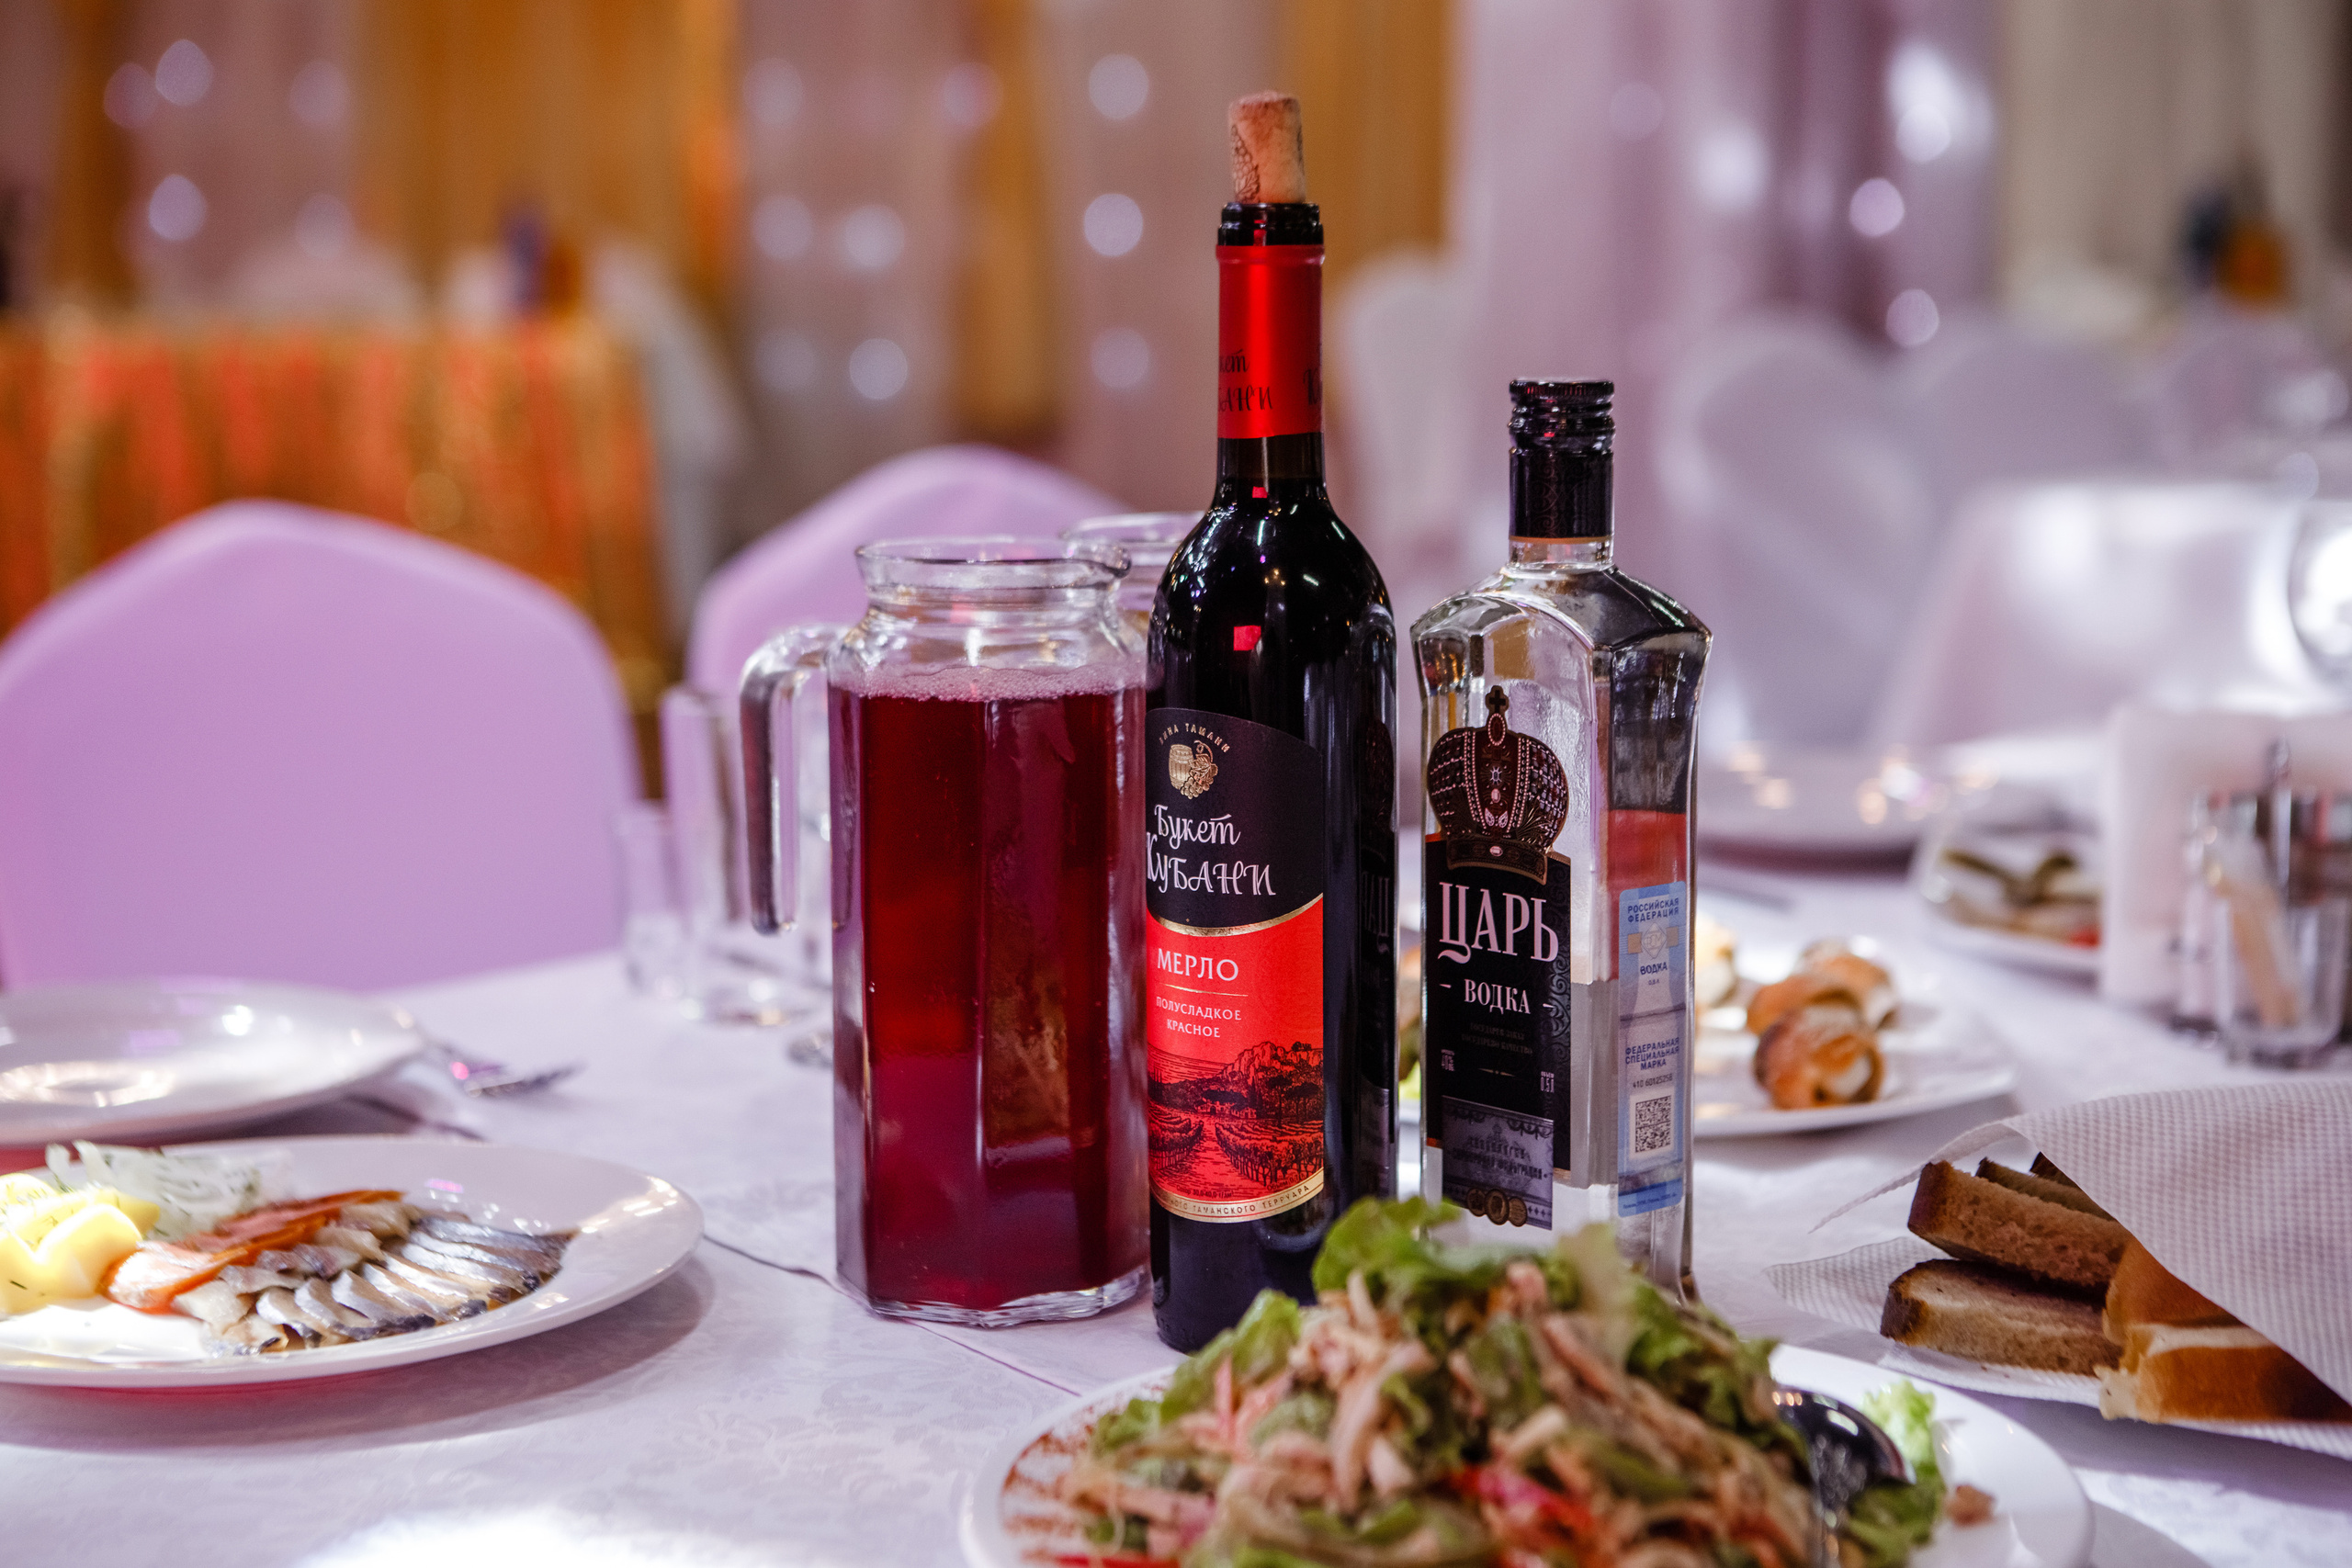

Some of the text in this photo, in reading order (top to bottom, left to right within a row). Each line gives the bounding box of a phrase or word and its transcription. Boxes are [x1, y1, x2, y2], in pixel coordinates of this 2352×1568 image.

[1184, 722, 1231, 753] ТАМАНИ
[1153, 803, 1241, 850] Букет
[1627, 897, 1679, 914] РОССИЙСКАЯ
[1627, 907, 1679, 923] ФЕДЕРАЦИЯ
[1438, 881, 1559, 964] ЦАРЬ
[1157, 948, 1239, 982] МЕРЛО
[1640, 962, 1668, 976] ВОДКА
[1464, 978, 1532, 1014] ВОДКА
[1156, 996, 1242, 1021] ПОЛУСЛАДКОЕ
[1167, 1019, 1221, 1038] КРАСНОЕ
[1625, 1037, 1679, 1055] ФЕДЕРАЛЬНАЯ
[1625, 1046, 1679, 1065] СПЕЦИАЛЬНАЯ
[1640, 1058, 1667, 1070] МАРКА
[1193, 1203, 1256, 1215] ТАМАНСКОГО
[1261, 1185, 1309, 1209] ТЕРРУАРА
